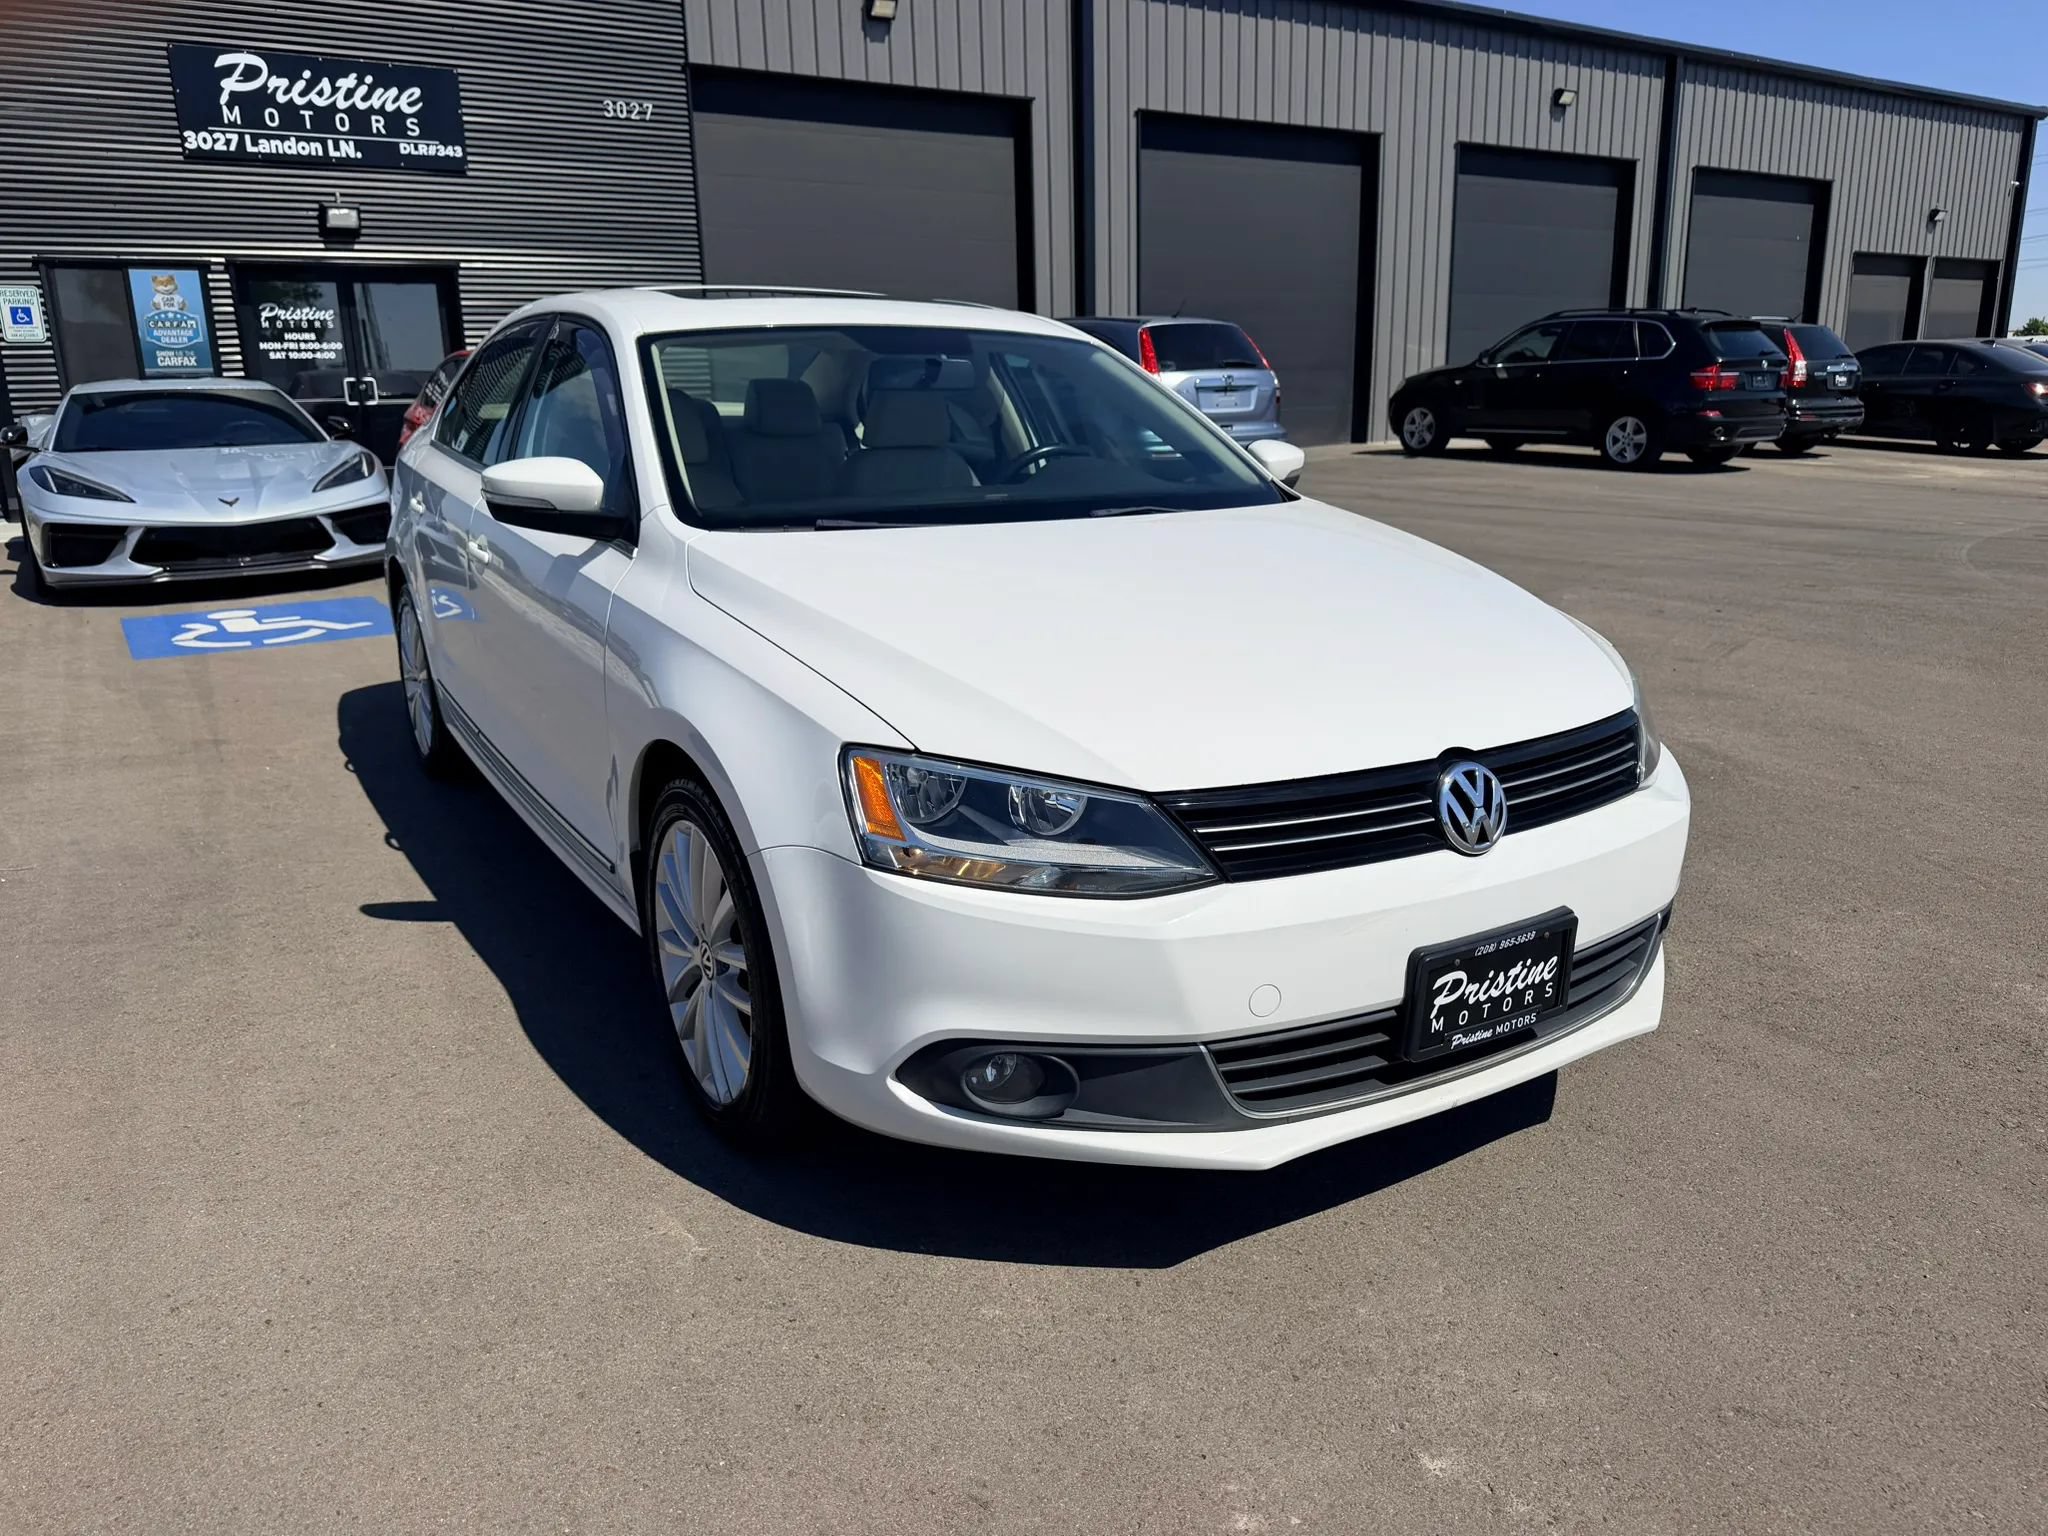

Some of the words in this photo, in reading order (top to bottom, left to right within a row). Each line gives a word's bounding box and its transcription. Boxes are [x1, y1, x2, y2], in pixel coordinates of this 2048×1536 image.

[214, 53, 423, 114] Pristine
[603, 100, 653, 120] 3027
[222, 105, 420, 136] MOTORS
[183, 131, 238, 151] 3027
[245, 134, 323, 156] Landon
[327, 139, 362, 159] LN.
[399, 142, 463, 158] DLR#343
[259, 303, 335, 321] Pristine
[261, 320, 334, 329] MOTORS
[259, 341, 299, 350] MON-FRI
[284, 332, 316, 341] HOURS
[157, 356, 197, 367] CARFAX
[269, 351, 287, 359] SAT
[1475, 942, 1497, 957] (208)
[1430, 955, 1558, 1019] Pristine
[1431, 983, 1553, 1033] MOTORS
[1451, 1028, 1494, 1049] Pristine
[1496, 1013, 1537, 1035] MOTORS
